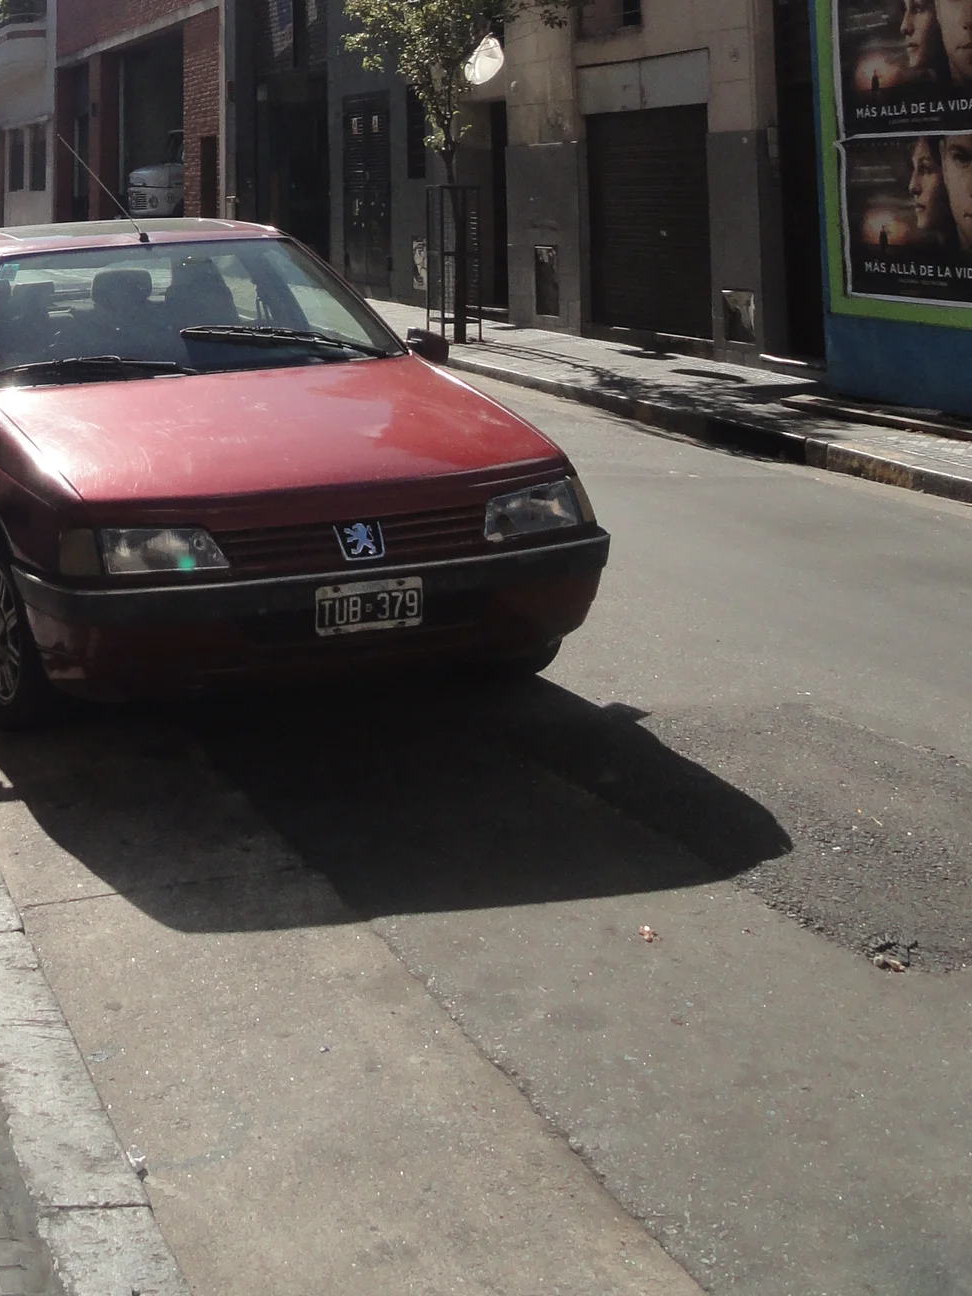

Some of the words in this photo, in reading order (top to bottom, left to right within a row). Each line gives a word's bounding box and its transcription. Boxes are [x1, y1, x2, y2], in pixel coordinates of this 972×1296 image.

[856, 105, 877, 118] MÁS
[880, 102, 907, 116] ALLÁ
[911, 103, 926, 114] DE
[929, 101, 944, 112] LA
[864, 260, 886, 273] MÁS
[890, 261, 916, 275] ALLÁ
[920, 265, 934, 277] DE
[937, 266, 952, 278] LA
[321, 596, 362, 626] TUB
[377, 589, 418, 619] 379
